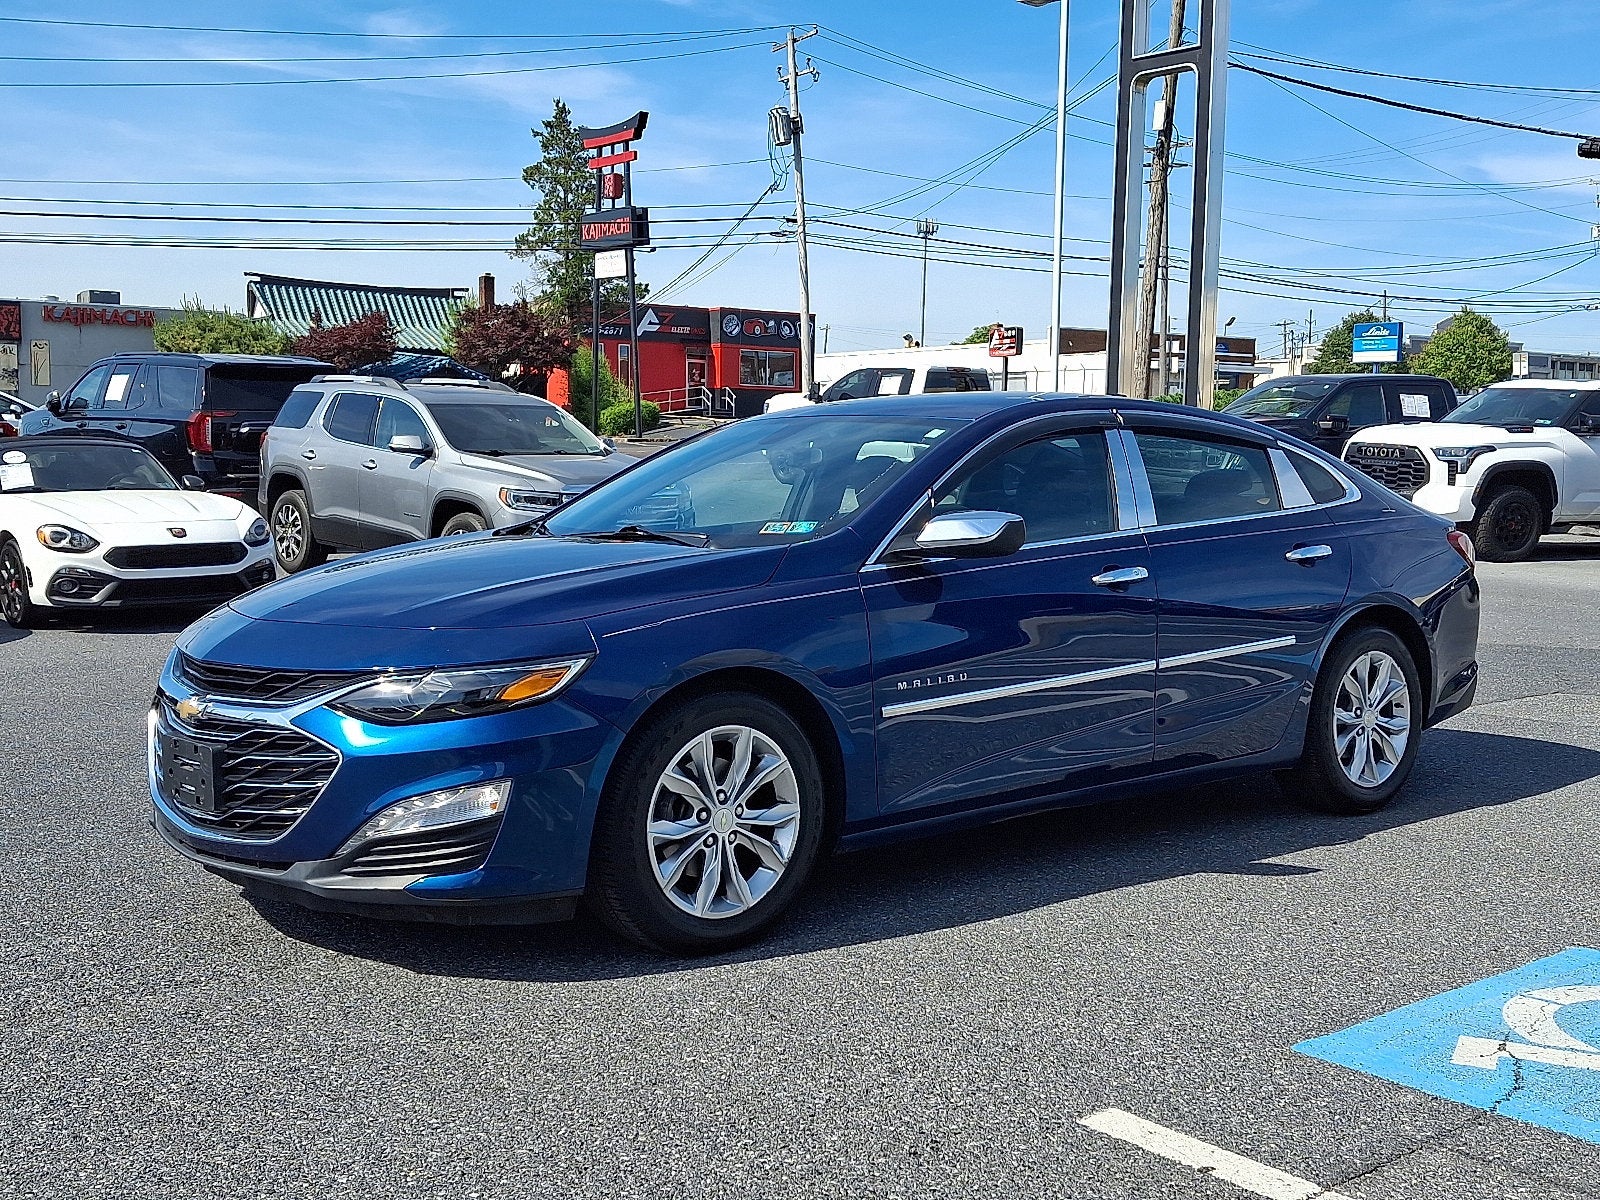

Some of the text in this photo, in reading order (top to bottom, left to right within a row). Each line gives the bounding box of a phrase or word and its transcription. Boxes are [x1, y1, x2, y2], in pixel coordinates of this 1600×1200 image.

[582, 217, 630, 240] KAJIMACHI
[42, 305, 156, 328] KAJIMACHI
[1361, 446, 1400, 458] TOYOTA
[897, 672, 967, 691] MALIBU
